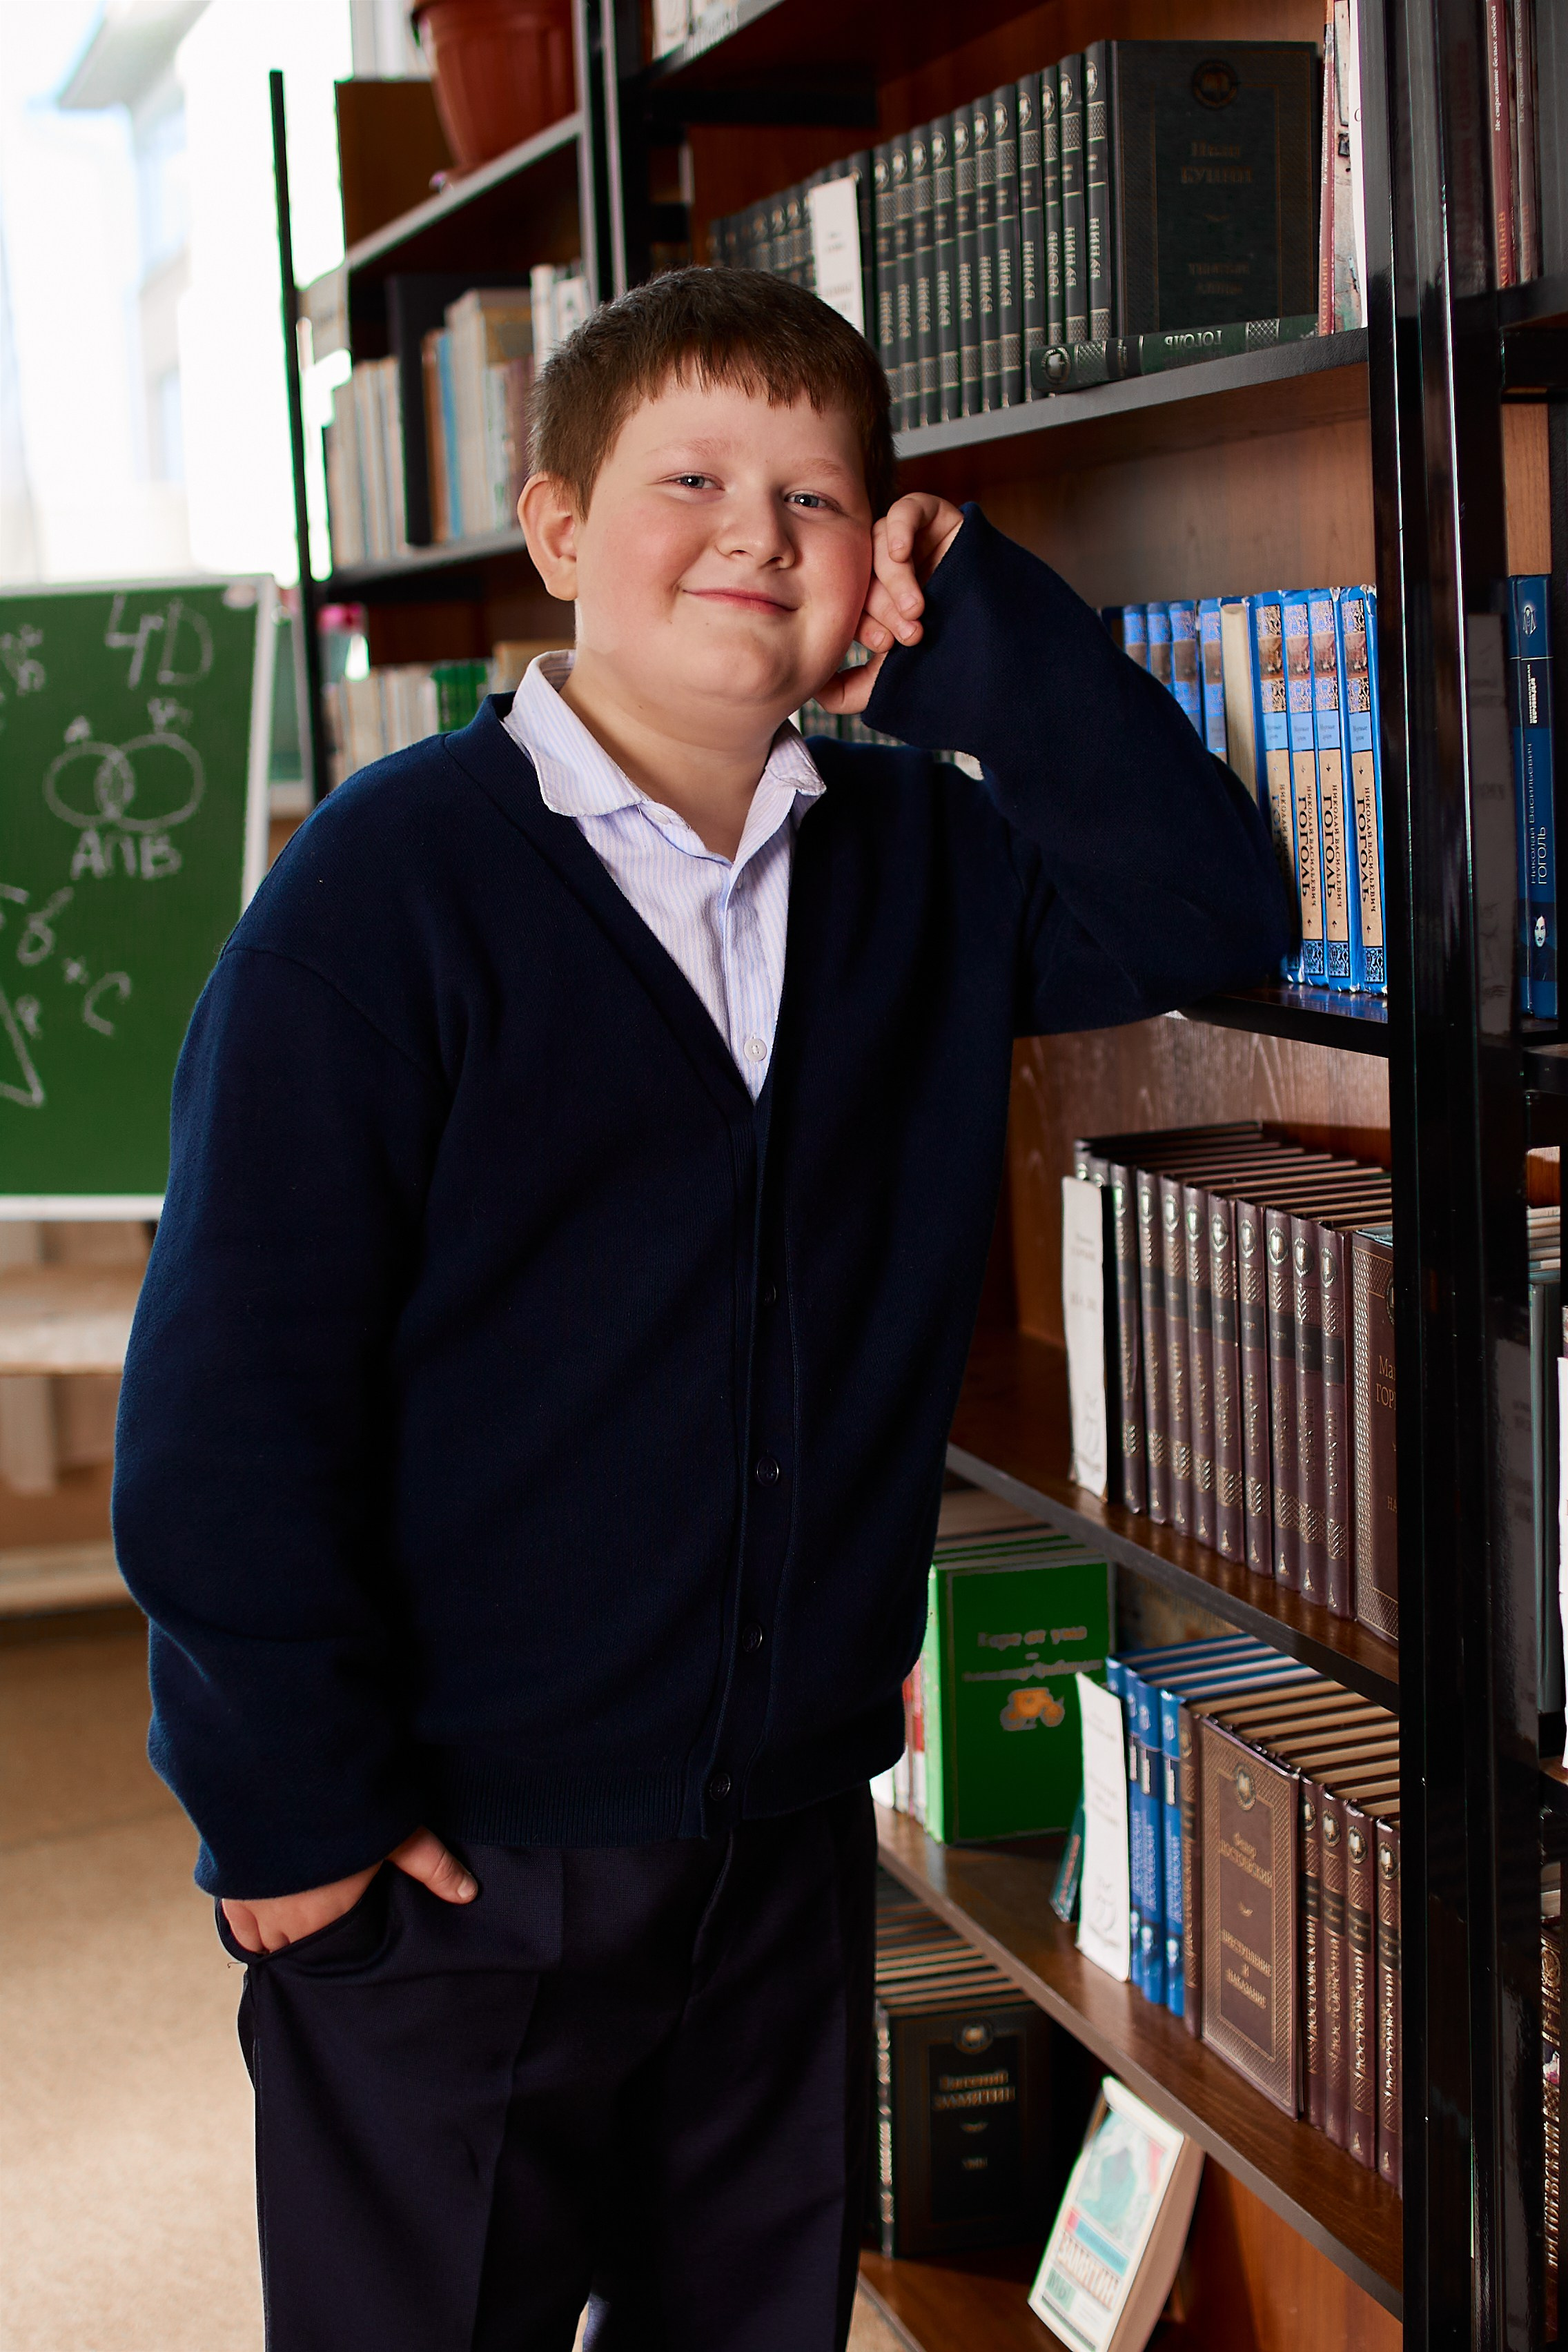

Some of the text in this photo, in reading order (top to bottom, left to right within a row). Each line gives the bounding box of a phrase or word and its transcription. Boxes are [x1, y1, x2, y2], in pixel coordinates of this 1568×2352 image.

[1490, 5, 1498, 39] лебедей
[1493, 69, 1502, 118] стреляйте
[1494, 119, 1501, 131] Не
[1048, 231, 1059, 296] ГОГОЛЬ
[1064, 226, 1077, 286] БУНИН
[1090, 217, 1101, 279] БУНИН
[1498, 211, 1510, 288] АСИЛЬЕВ
[1164, 330, 1222, 349] ГОГОЛЬ
[1298, 796, 1311, 897] ГОГОЛЬ
[1309, 838, 1317, 907] ВАСИЛЬЕВИЧ
[1323, 795, 1337, 898] ГОГОЛЬ
[1334, 836, 1342, 908] ВАСИЛЬЕВИЧ
[1357, 798, 1369, 903] ГОГОЛЬ
[1366, 840, 1376, 912] ВАСИЛЬЕВИЧ
[1537, 827, 1547, 885] ГОГОЛЬ
[1353, 1954, 1366, 2073] ДОСТОЕВСКИЙ
[1384, 1972, 1397, 2093] ДОСТОЕВСКИЙ
